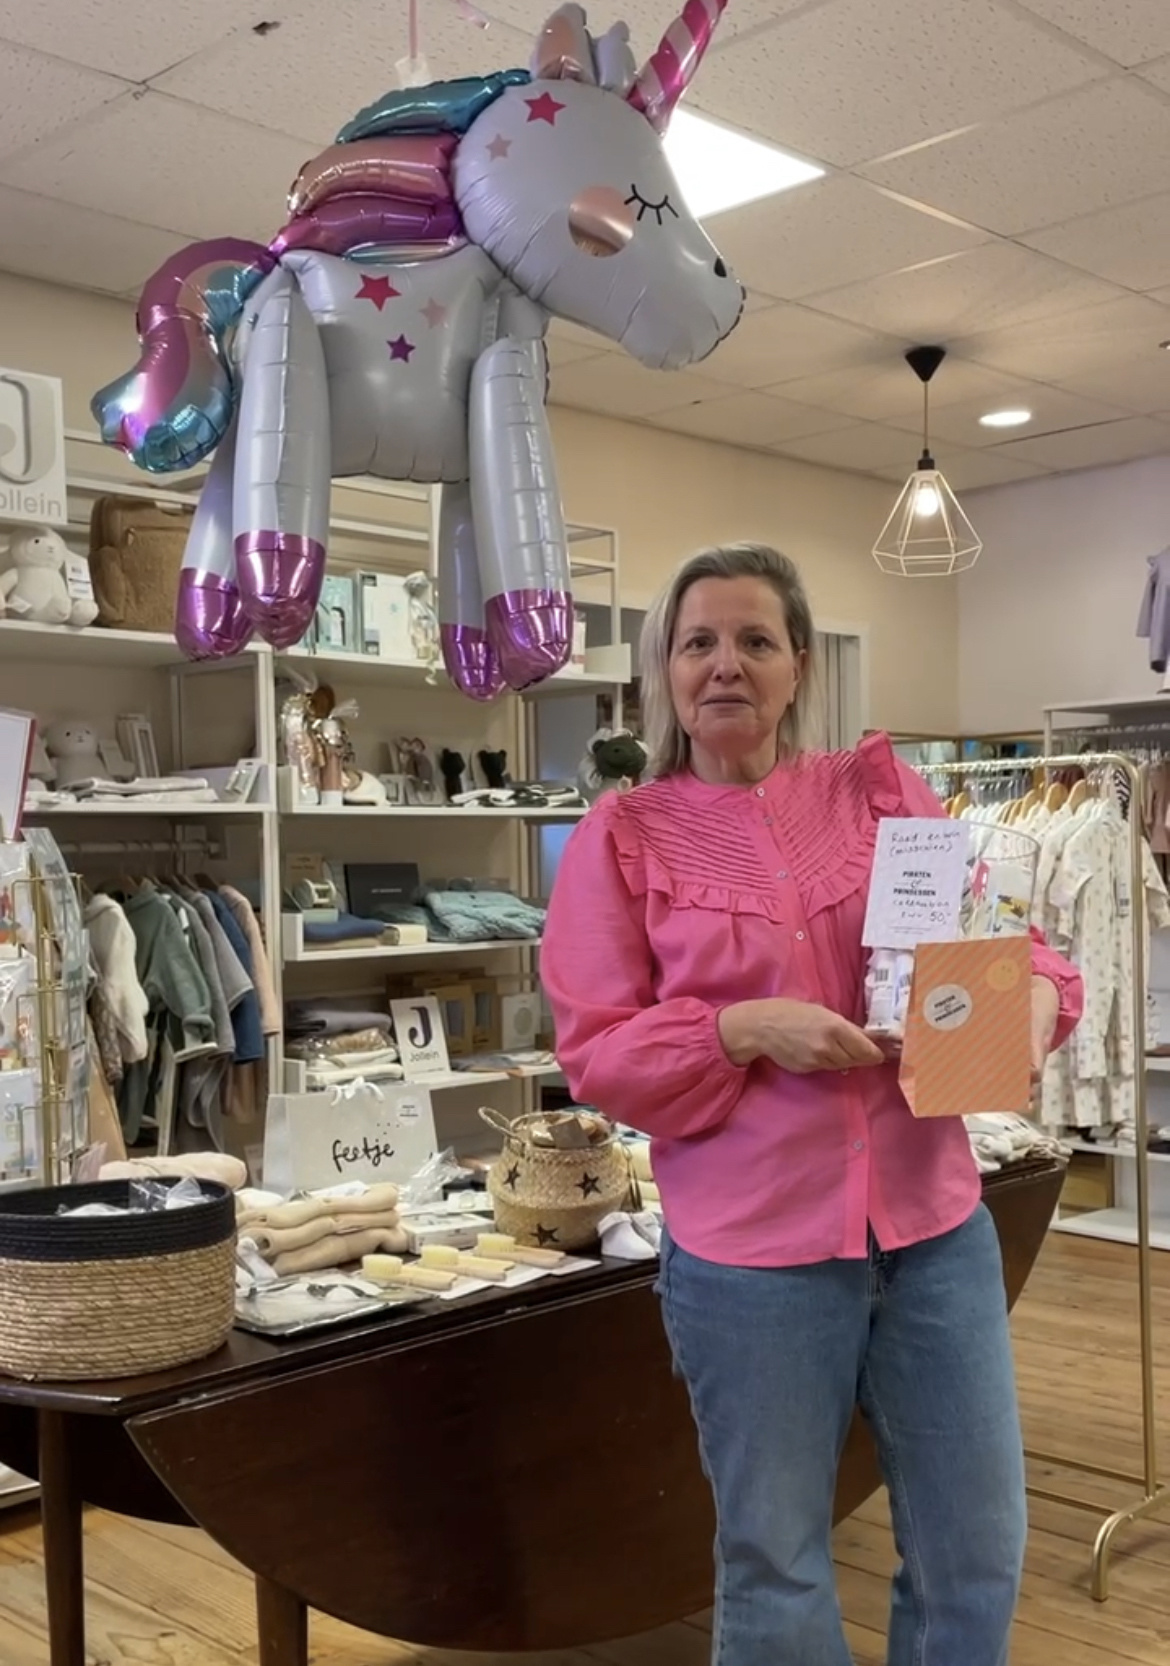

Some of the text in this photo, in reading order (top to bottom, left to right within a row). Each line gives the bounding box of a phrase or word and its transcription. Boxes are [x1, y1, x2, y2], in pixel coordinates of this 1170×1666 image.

[0, 489, 62, 517] ollein
[902, 870, 932, 879] PIRATEN
[408, 1005, 433, 1049] J
[332, 1136, 395, 1174] feetje
